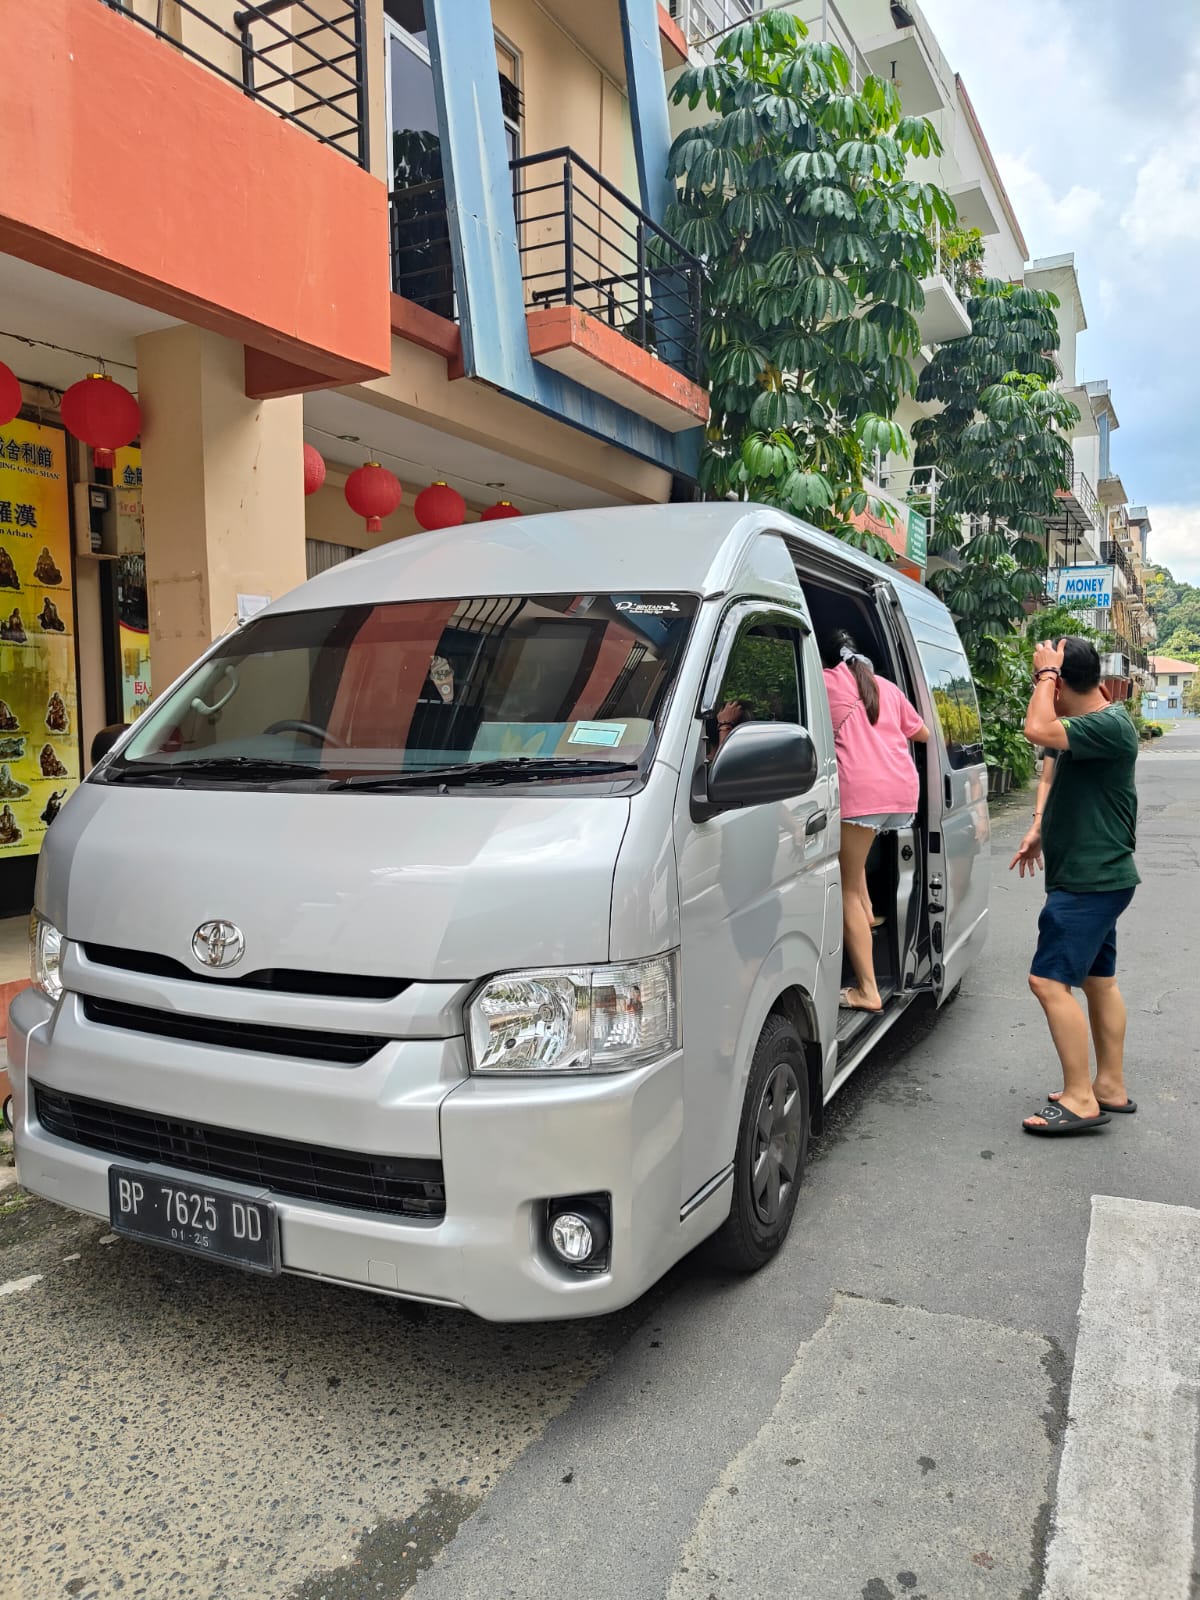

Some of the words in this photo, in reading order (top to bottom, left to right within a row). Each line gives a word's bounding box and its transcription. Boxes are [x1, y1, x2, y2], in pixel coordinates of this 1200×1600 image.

[7, 528, 33, 539] Arhats
[1066, 578, 1104, 592] MONEY
[119, 1178, 144, 1215] BP
[161, 1188, 217, 1232] 7625
[232, 1202, 262, 1242] DD
